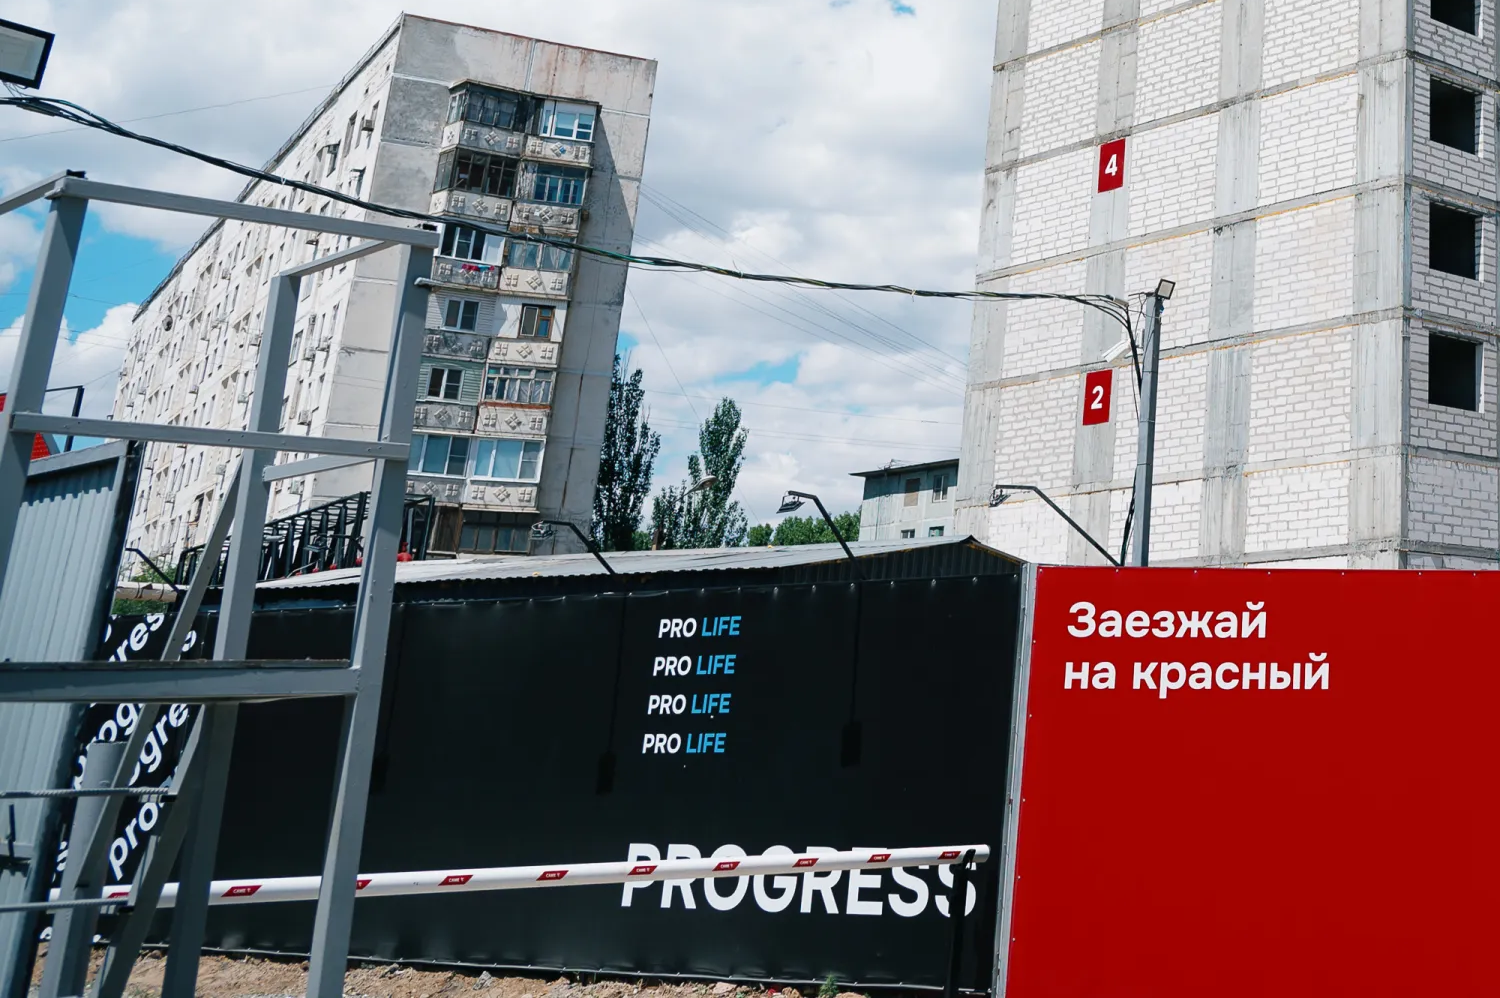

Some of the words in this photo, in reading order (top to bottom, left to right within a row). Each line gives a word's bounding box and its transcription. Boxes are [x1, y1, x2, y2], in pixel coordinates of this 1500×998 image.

[1105, 154, 1117, 176] 4
[1091, 386, 1103, 409] 2
[658, 617, 697, 638] PRO
[701, 616, 742, 637] LIFE
[1067, 601, 1267, 638] Заезжай
[653, 656, 692, 676] PRO
[696, 654, 737, 675] LIFE
[1064, 662, 1116, 690] на
[1132, 652, 1330, 699] красный
[648, 695, 687, 715] PRO
[691, 693, 732, 714] LIFE
[642, 733, 682, 754] PRO
[686, 732, 727, 753] LIFE
